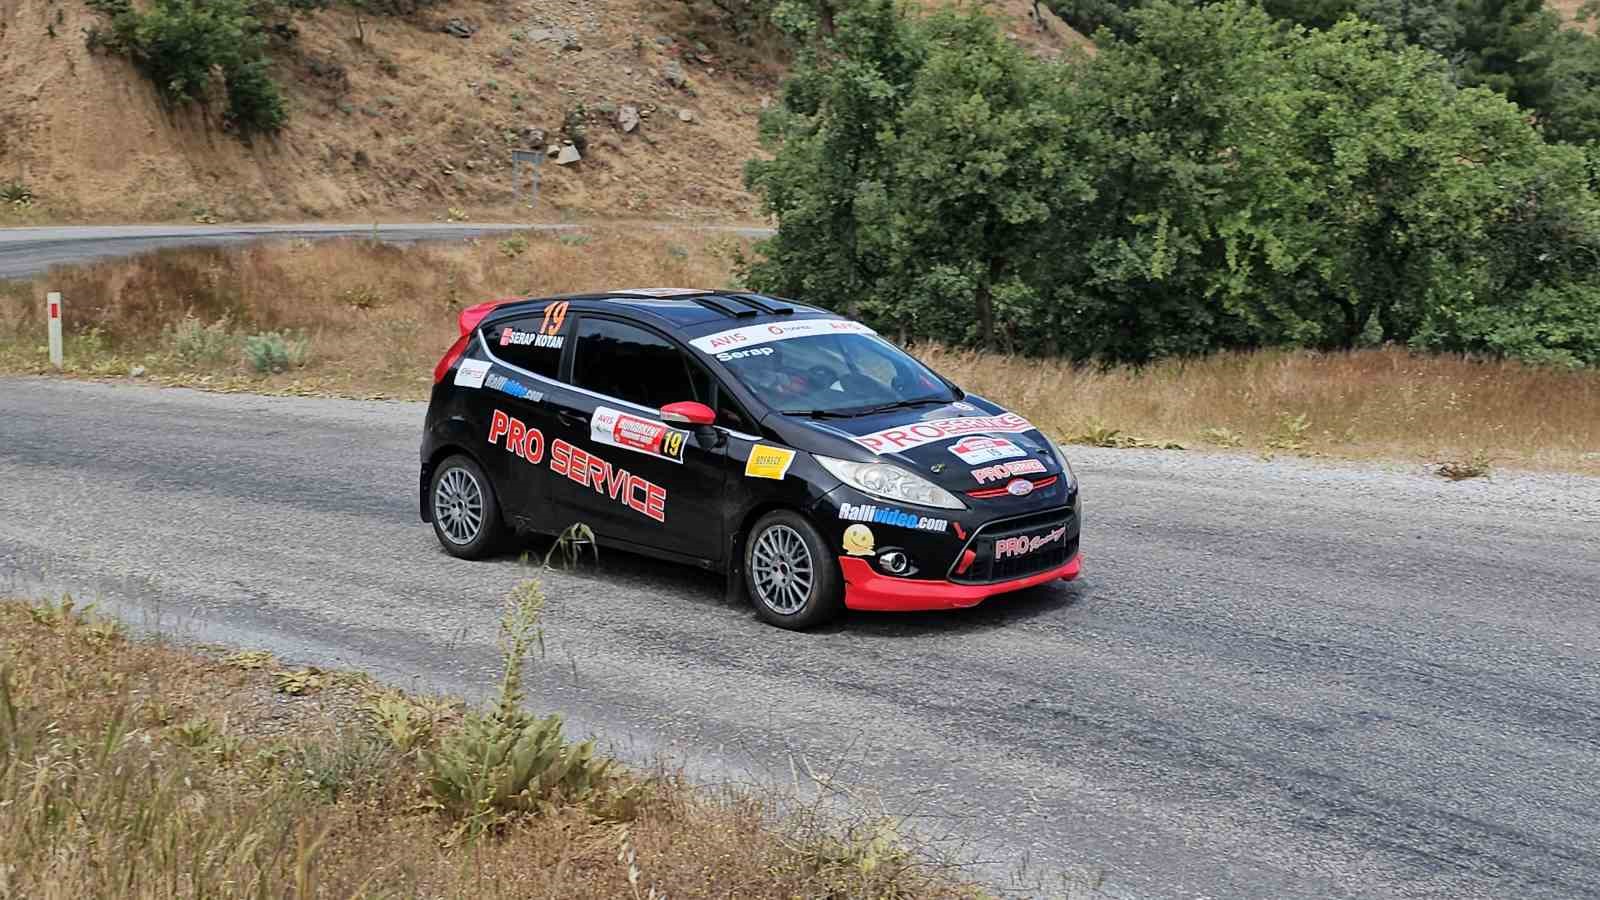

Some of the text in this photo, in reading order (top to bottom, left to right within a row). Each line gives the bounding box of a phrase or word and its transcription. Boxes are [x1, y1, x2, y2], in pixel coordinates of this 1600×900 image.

[540, 301, 569, 336] 19
[511, 332, 564, 349] SERAP KOTAN
[710, 333, 747, 348] AVIS
[716, 347, 774, 362] Serap
[663, 431, 682, 457] 19
[488, 409, 668, 523] PRO SERVICE
[839, 503, 948, 532] Rallivideo.com
[995, 537, 1029, 560] PRO
